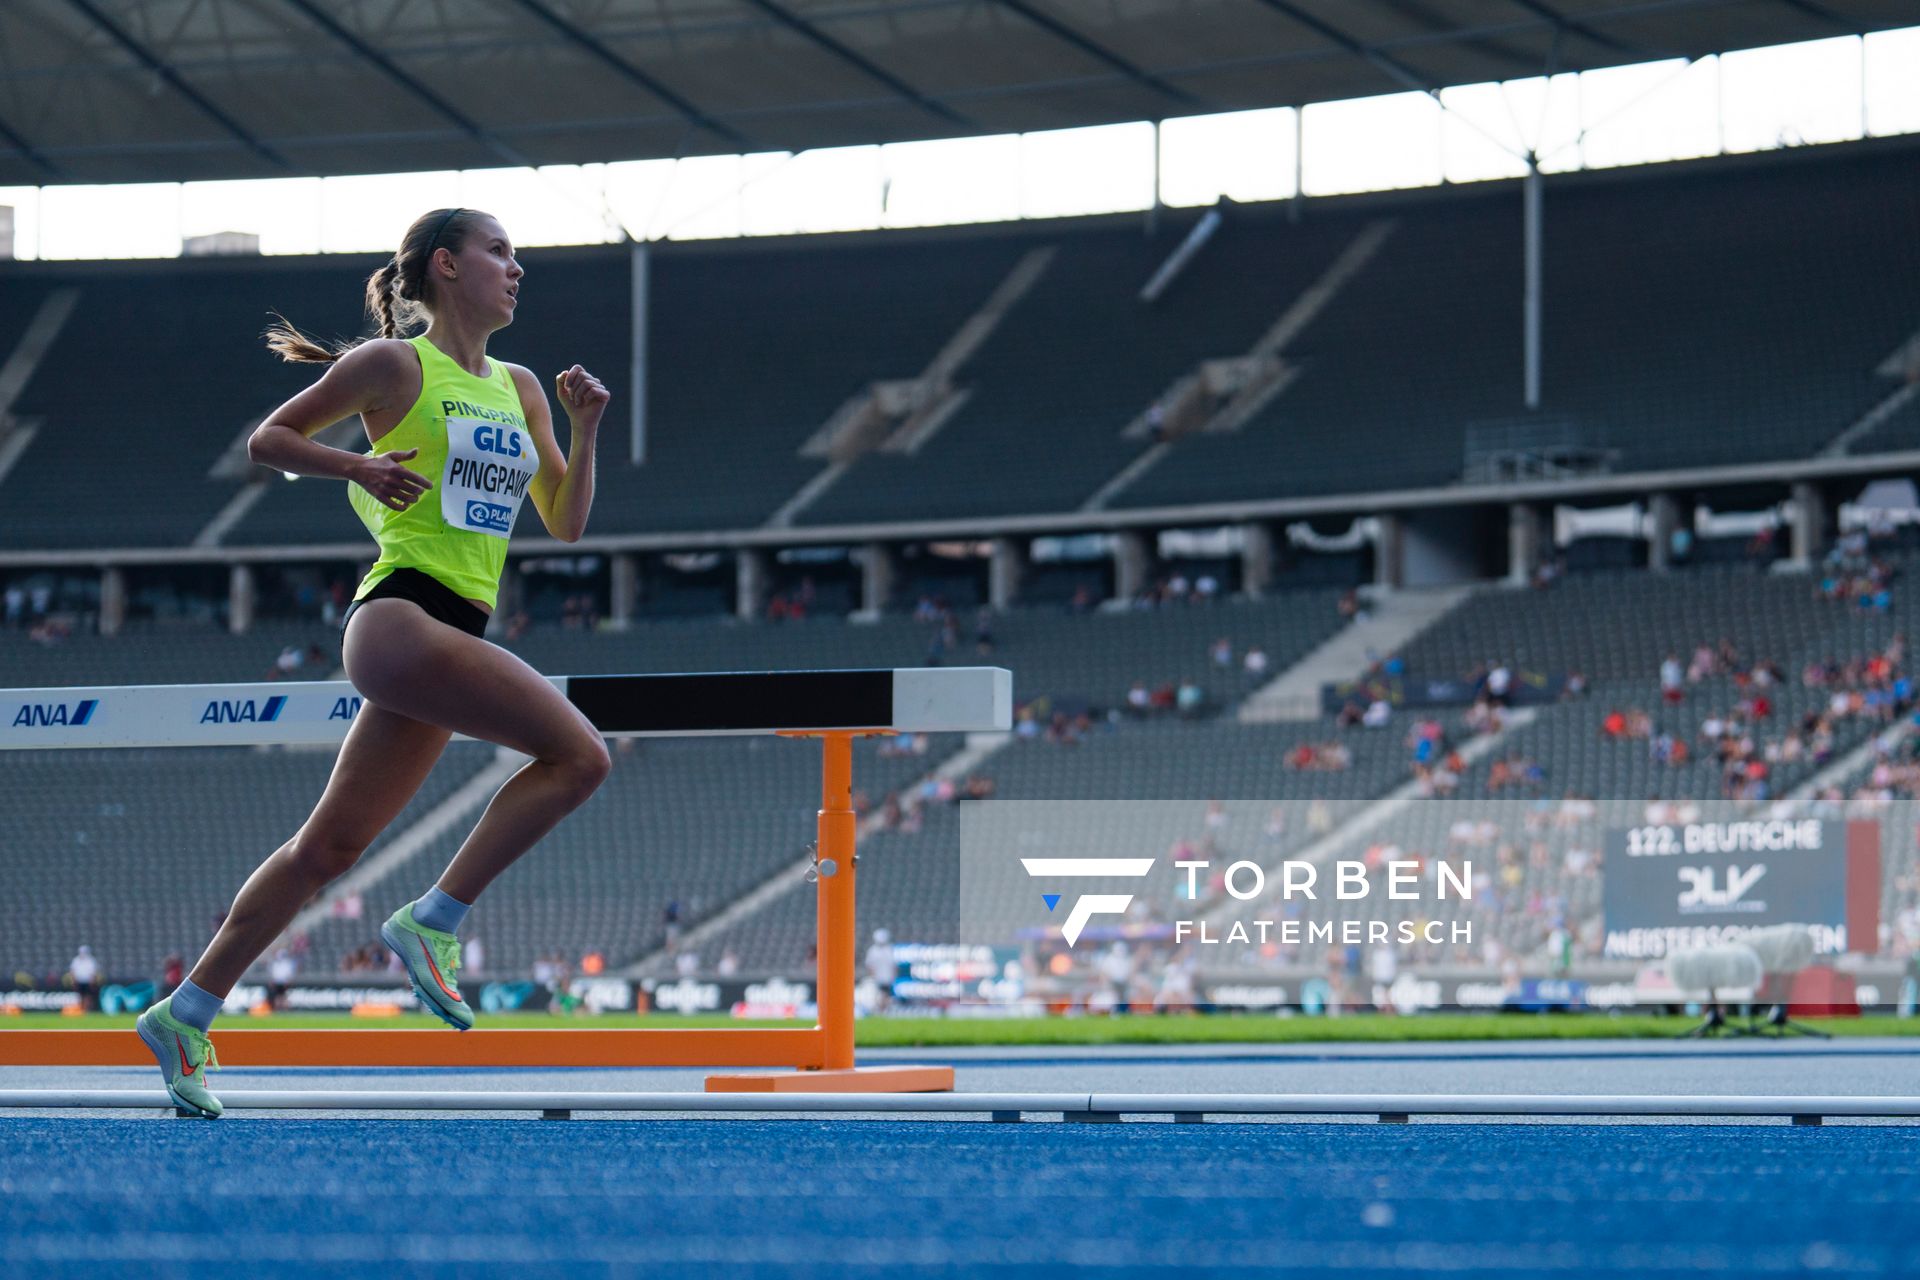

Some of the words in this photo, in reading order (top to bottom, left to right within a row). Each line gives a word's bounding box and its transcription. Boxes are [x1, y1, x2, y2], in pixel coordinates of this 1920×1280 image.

[449, 457, 533, 498] PINGPANK
[13, 704, 69, 727] ANA
[200, 700, 256, 724] ANA
[328, 697, 362, 720] AN
[1626, 825, 1682, 856] 122.
[1683, 819, 1822, 853] DEUTSCHE
